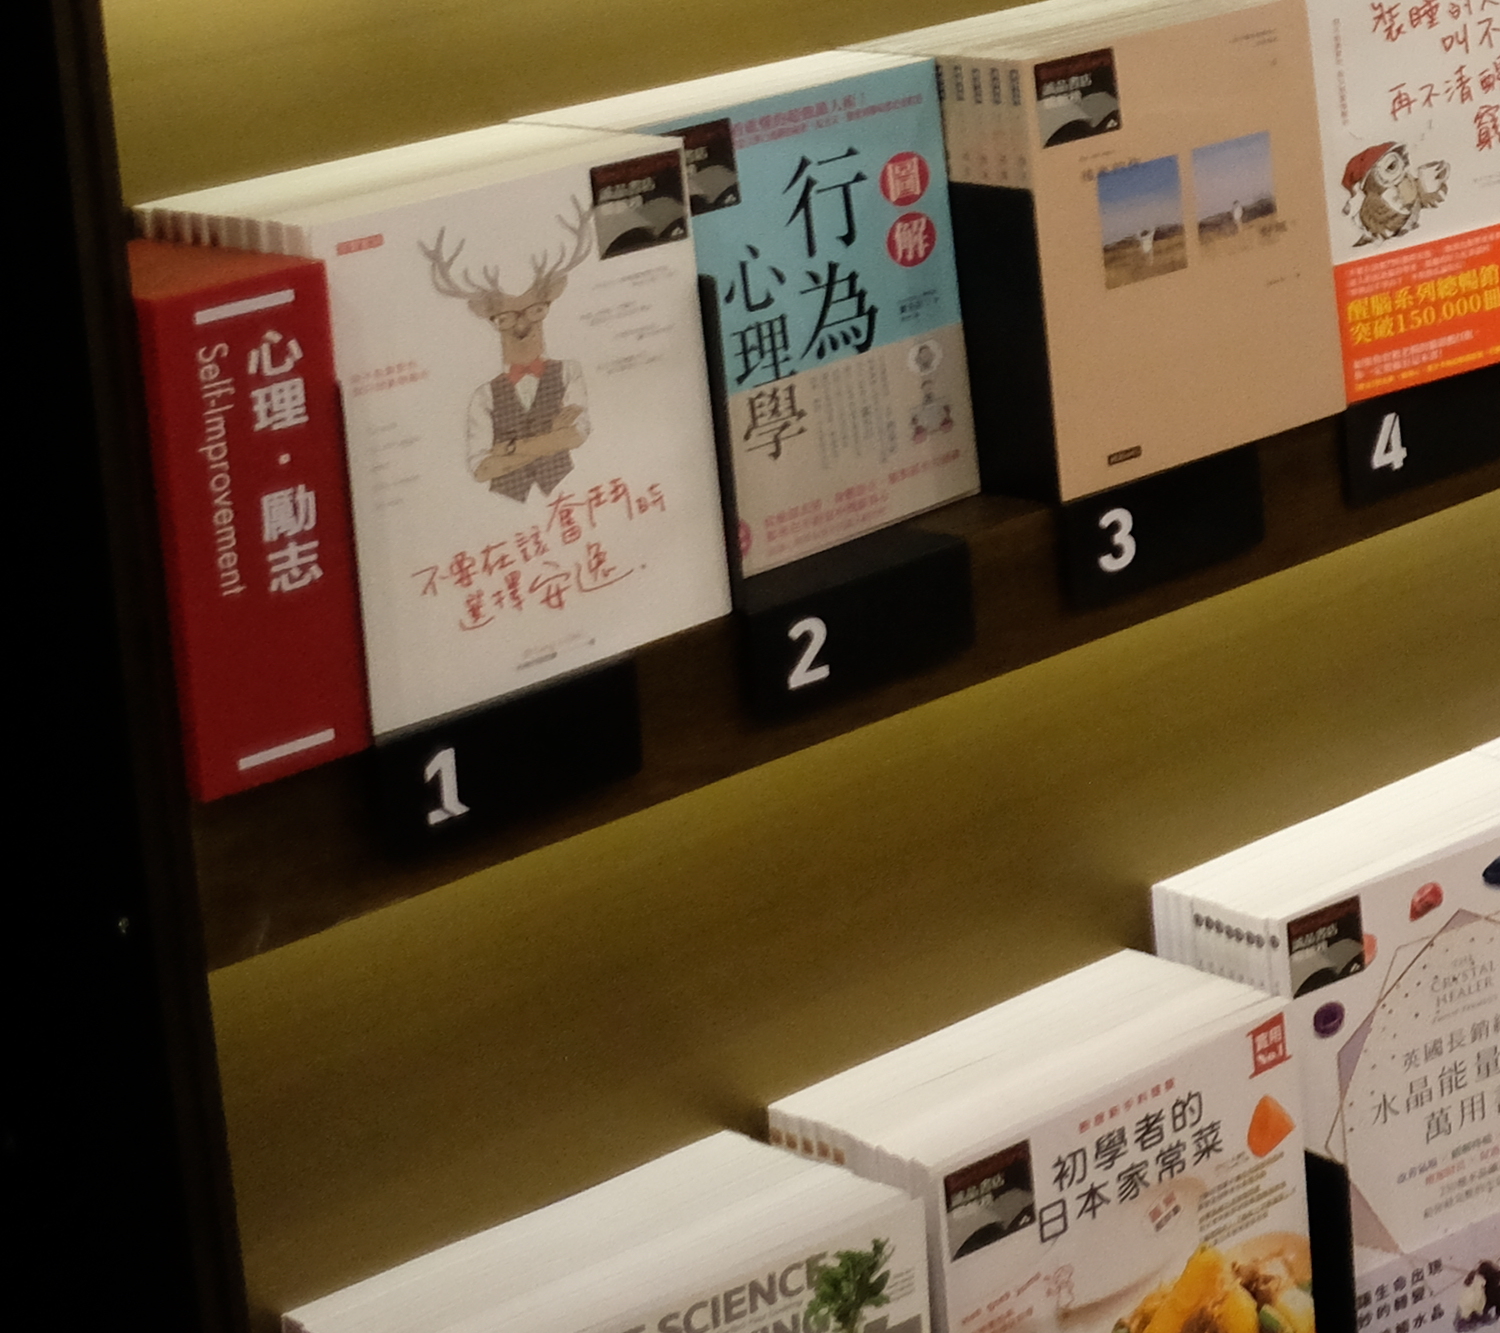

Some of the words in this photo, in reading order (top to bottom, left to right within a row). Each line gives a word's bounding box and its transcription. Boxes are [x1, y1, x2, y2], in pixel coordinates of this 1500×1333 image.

[781, 144, 881, 362] 行為
[721, 243, 808, 464] 心理學
[192, 340, 248, 599] Self-Improvement
[1371, 412, 1408, 472] 4
[1099, 506, 1137, 573] 3
[786, 616, 831, 691] 2
[424, 748, 471, 827] 1
[1034, 1119, 1227, 1243] 日本家常菜
[1049, 1091, 1207, 1194] 初學者的
